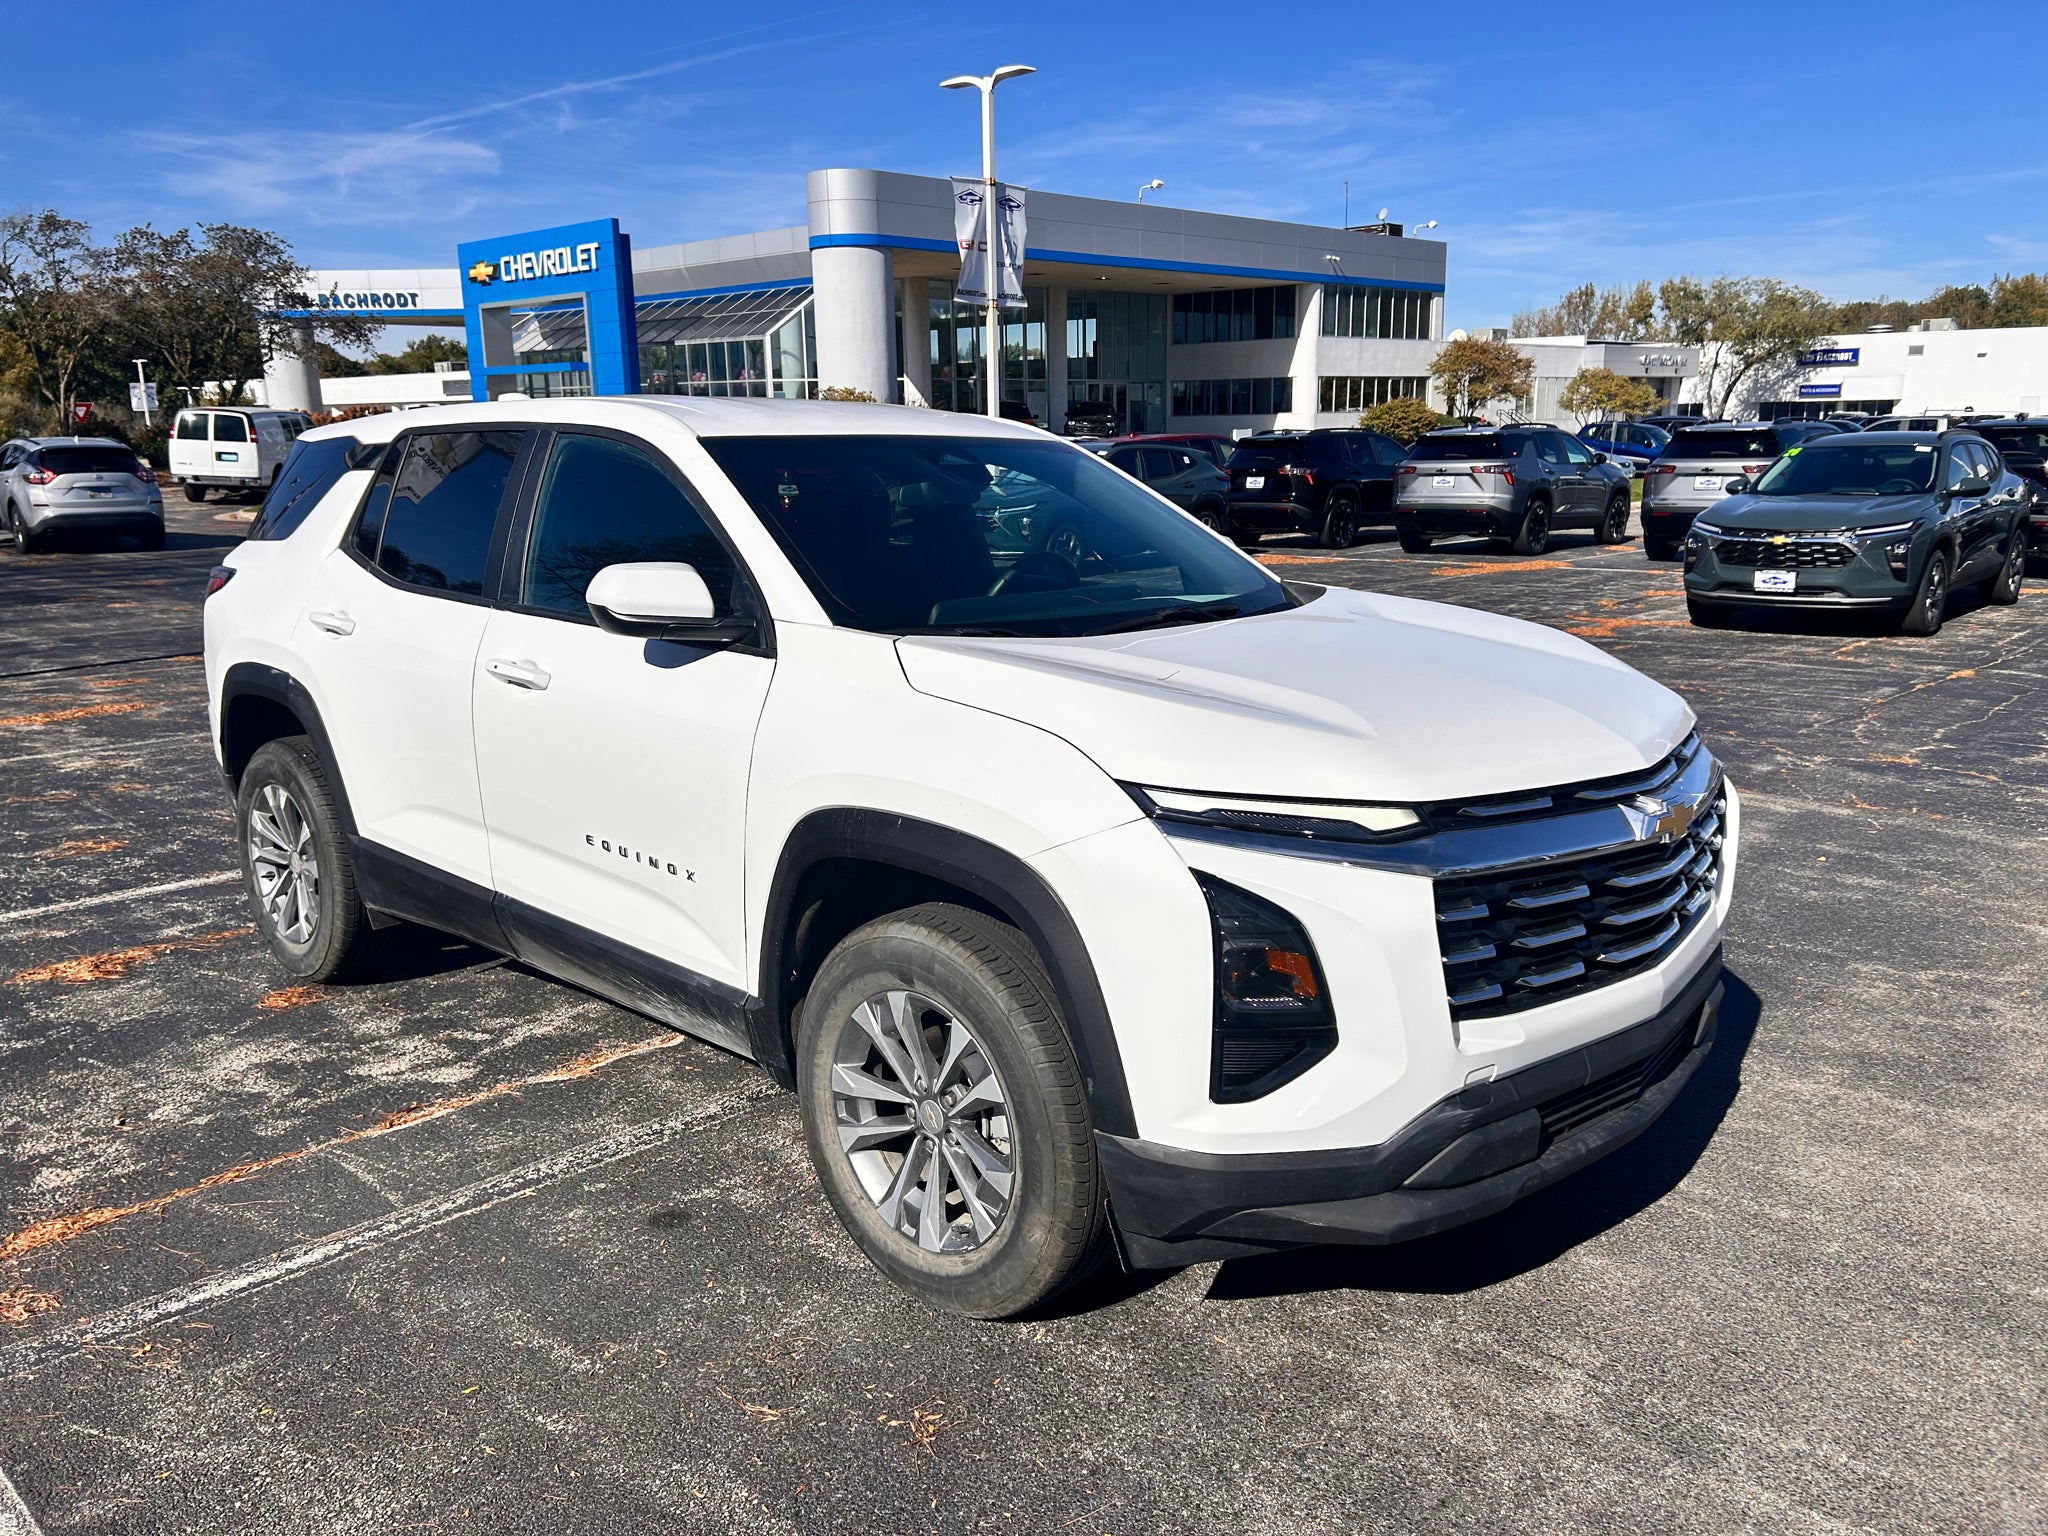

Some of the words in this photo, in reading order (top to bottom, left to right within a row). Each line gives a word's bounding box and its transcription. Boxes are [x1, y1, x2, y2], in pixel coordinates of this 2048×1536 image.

[500, 242, 599, 282] CHEVROLET
[317, 292, 419, 309] BACHRODT
[585, 834, 697, 883] EQUINOX
